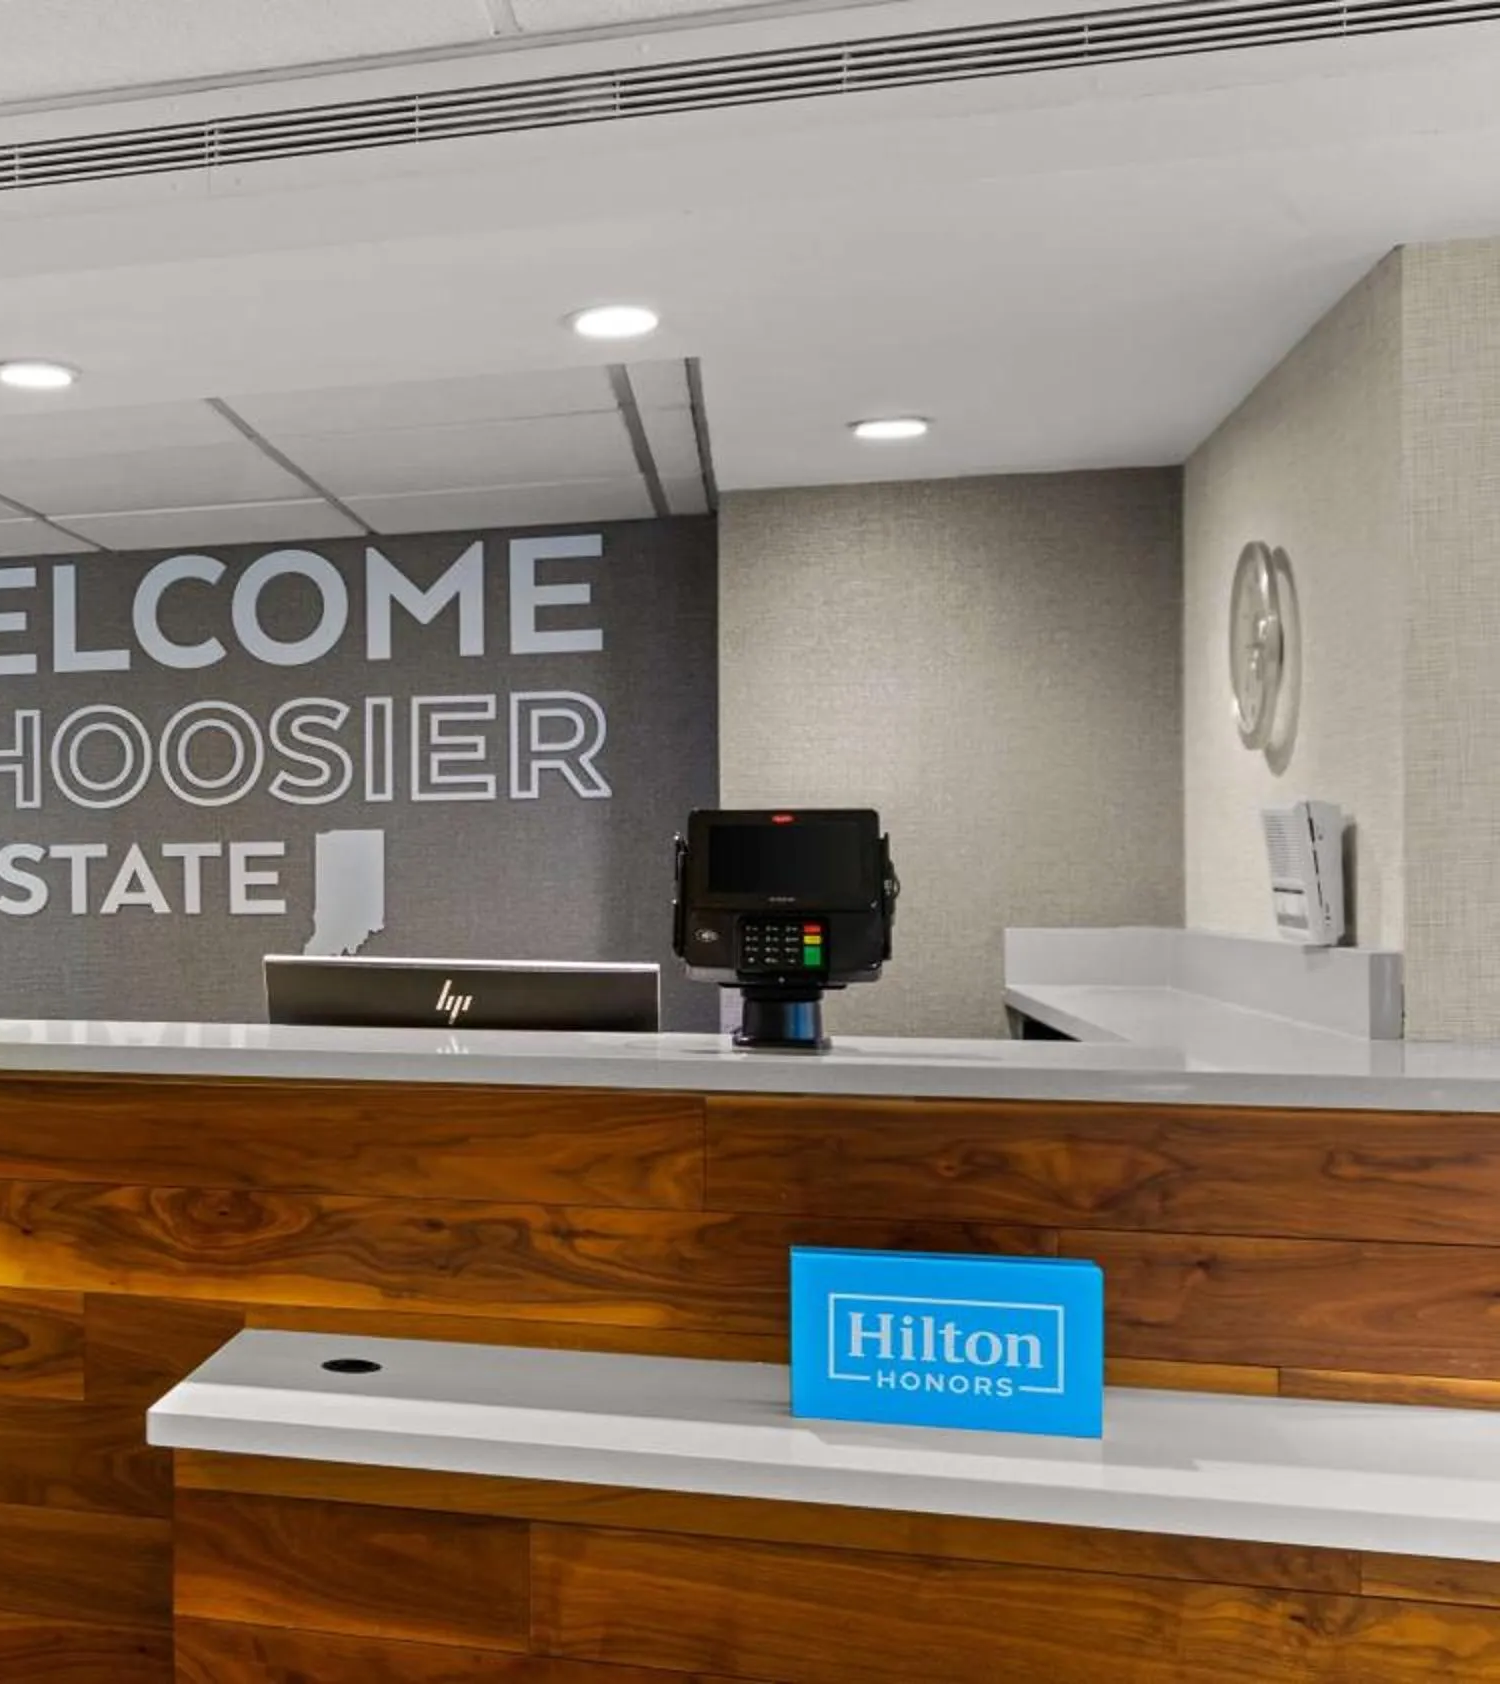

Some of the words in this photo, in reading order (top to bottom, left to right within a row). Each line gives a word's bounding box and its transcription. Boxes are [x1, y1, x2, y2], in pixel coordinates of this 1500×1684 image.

[435, 979, 473, 1025] hp
[848, 1312, 1044, 1369] Hilton
[876, 1369, 1013, 1397] HONORS
